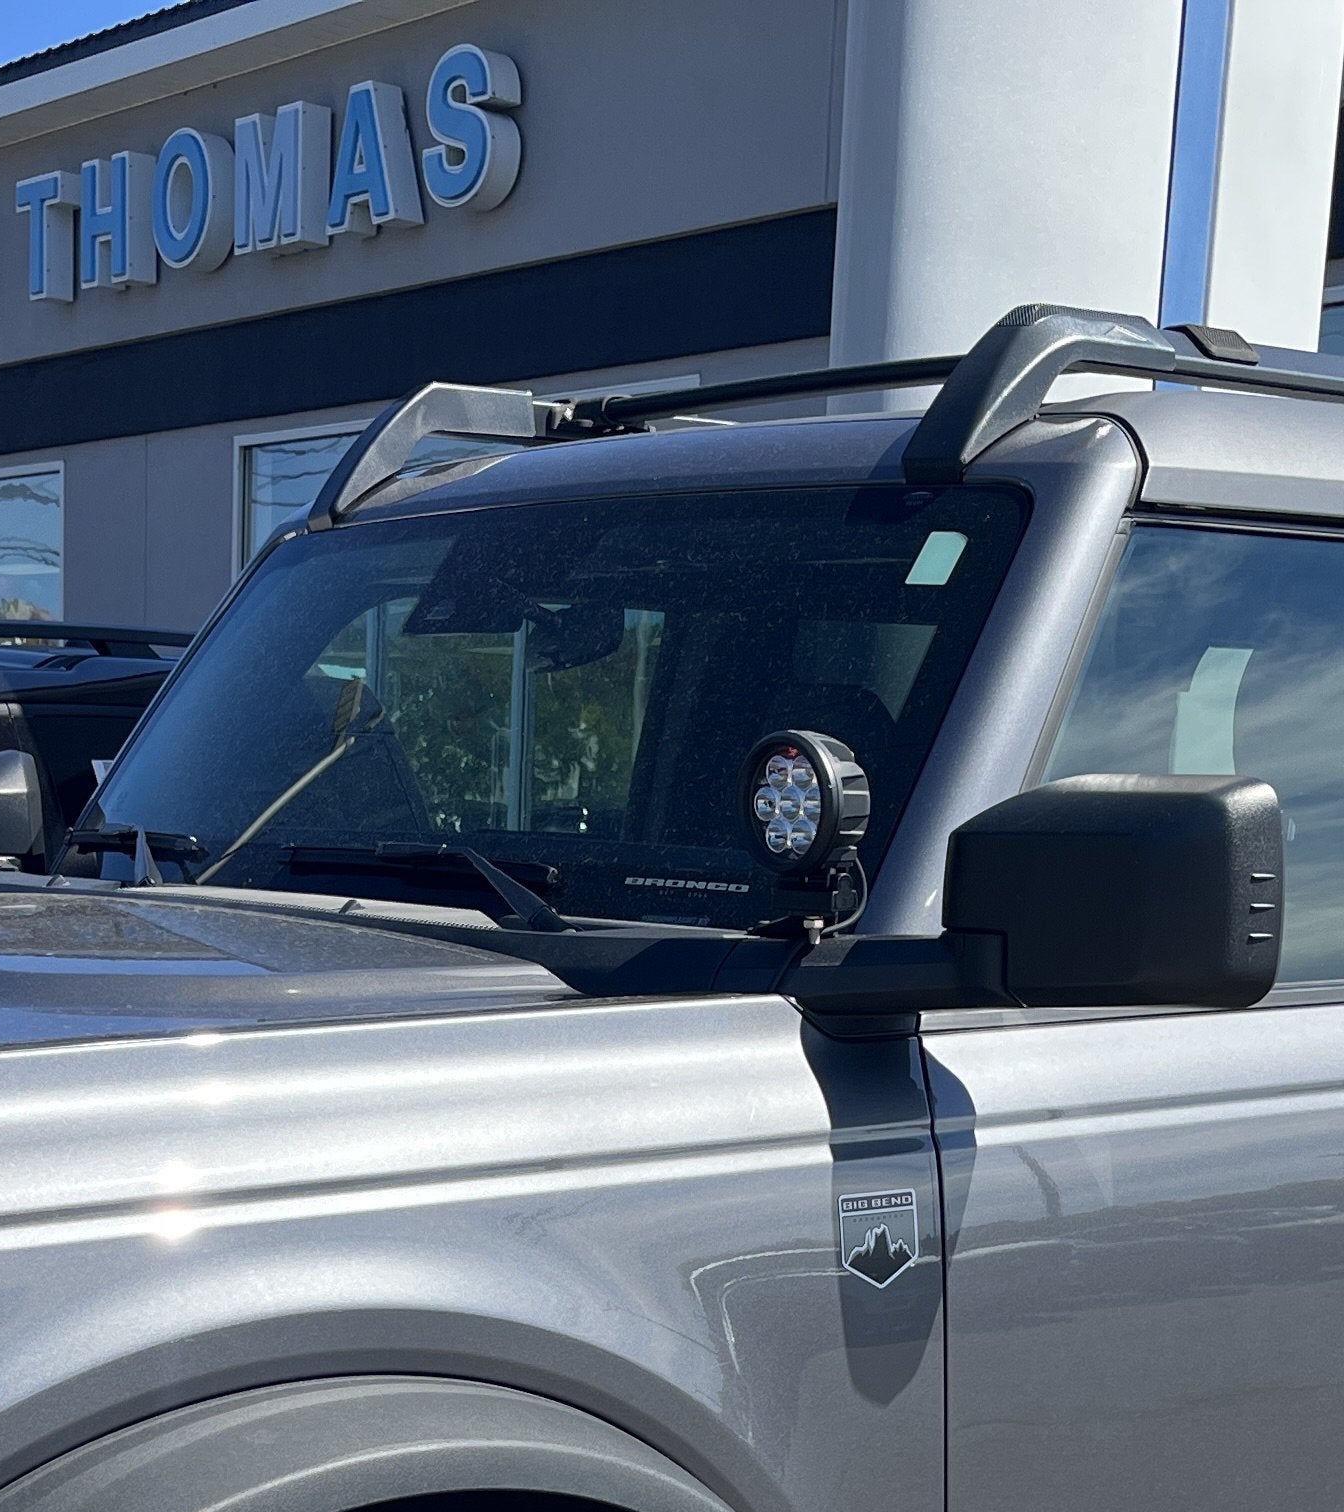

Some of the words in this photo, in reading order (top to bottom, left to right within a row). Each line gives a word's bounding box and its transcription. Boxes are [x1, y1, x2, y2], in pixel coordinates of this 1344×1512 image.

[16, 43, 522, 304] THOMAS
[624, 876, 750, 893] BRONCO
[842, 1199, 868, 1211] BIG
[871, 1195, 912, 1208] BEND
